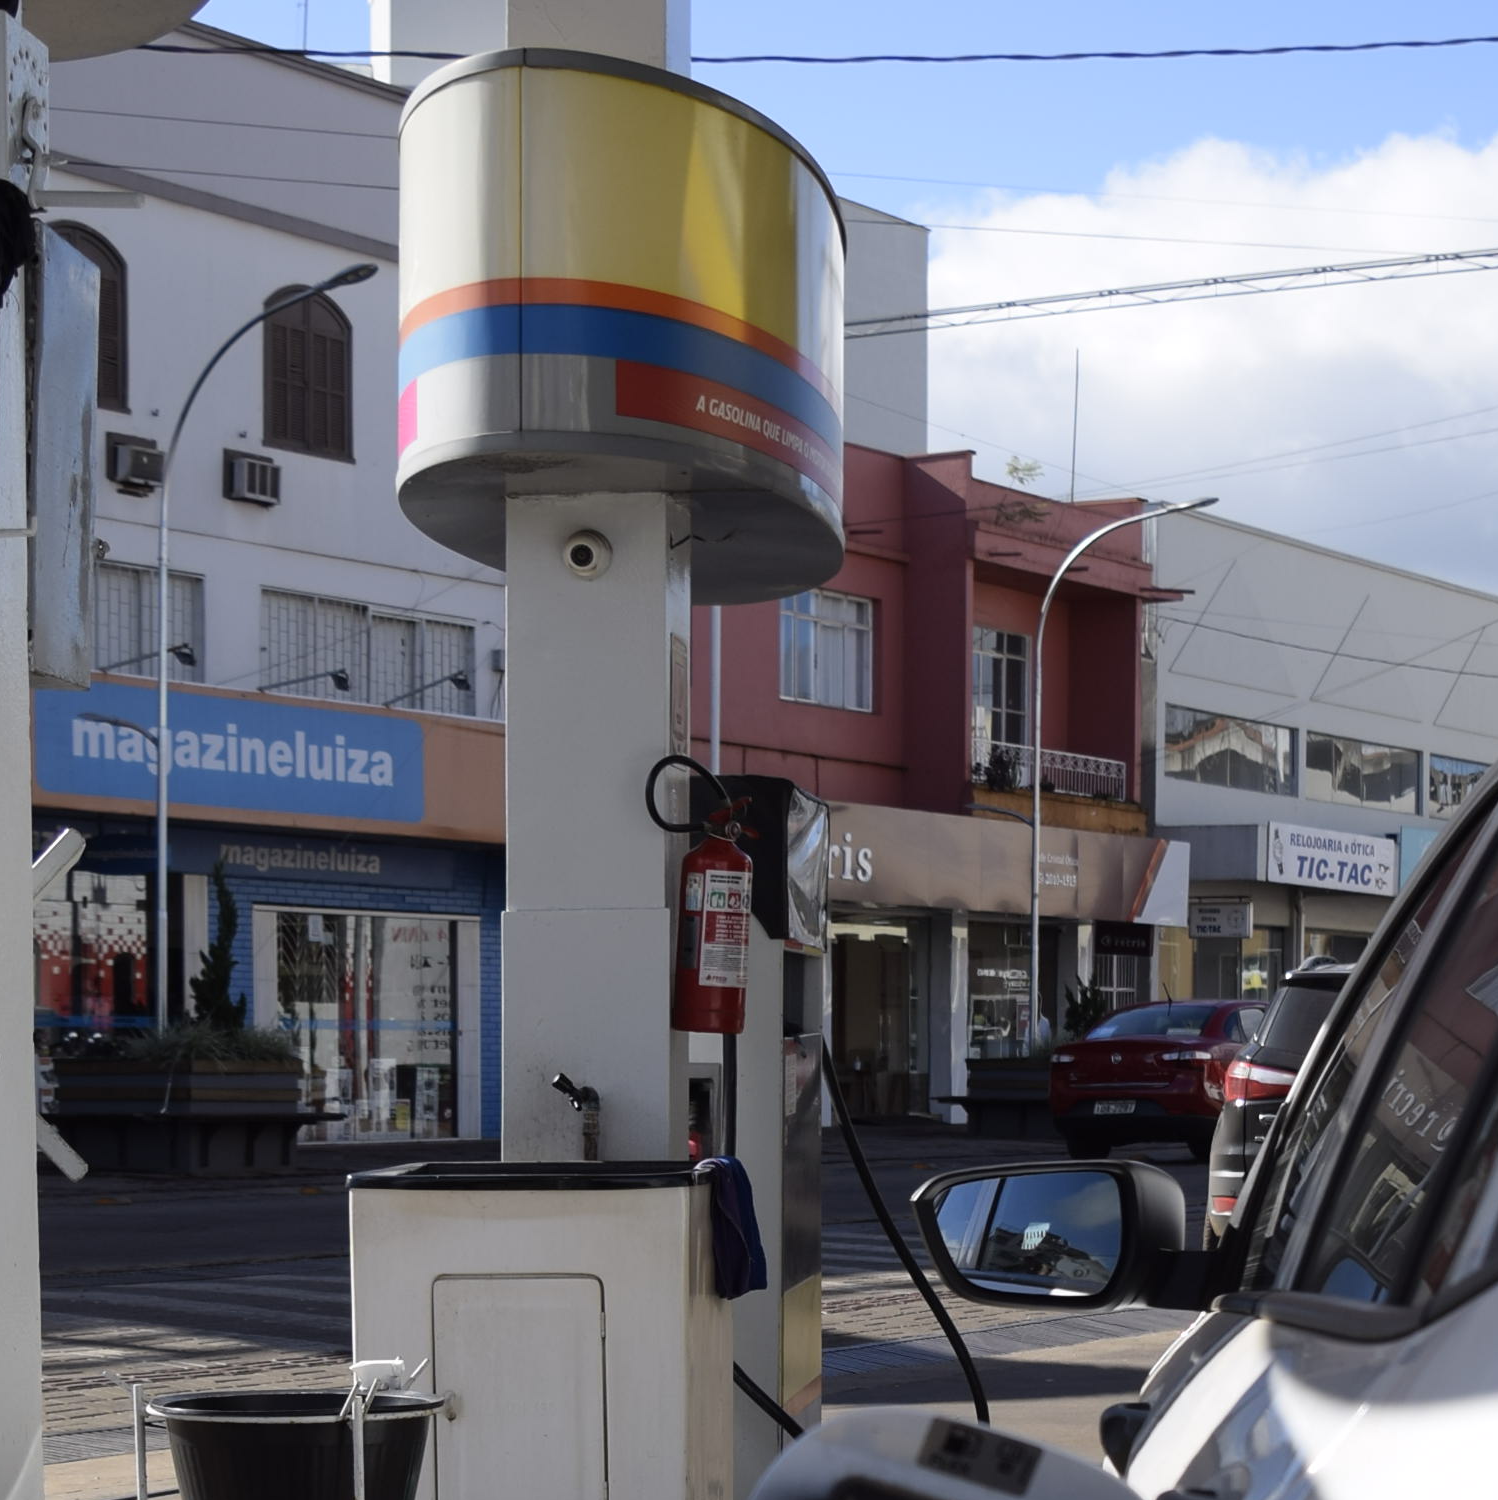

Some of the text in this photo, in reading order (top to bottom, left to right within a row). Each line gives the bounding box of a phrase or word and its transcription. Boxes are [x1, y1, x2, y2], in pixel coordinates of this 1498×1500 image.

[696, 395, 706, 412] A
[709, 399, 761, 433] GASOLINA
[763, 419, 781, 442] QUE
[72, 719, 394, 787] magazineluiza
[220, 844, 381, 873] magazineluiza
[828, 832, 873, 883] ris
[1290, 833, 1342, 852] RELOJOARIA
[1351, 839, 1375, 857] ÓTICA
[1297, 855, 1373, 886] TIC-TAC
